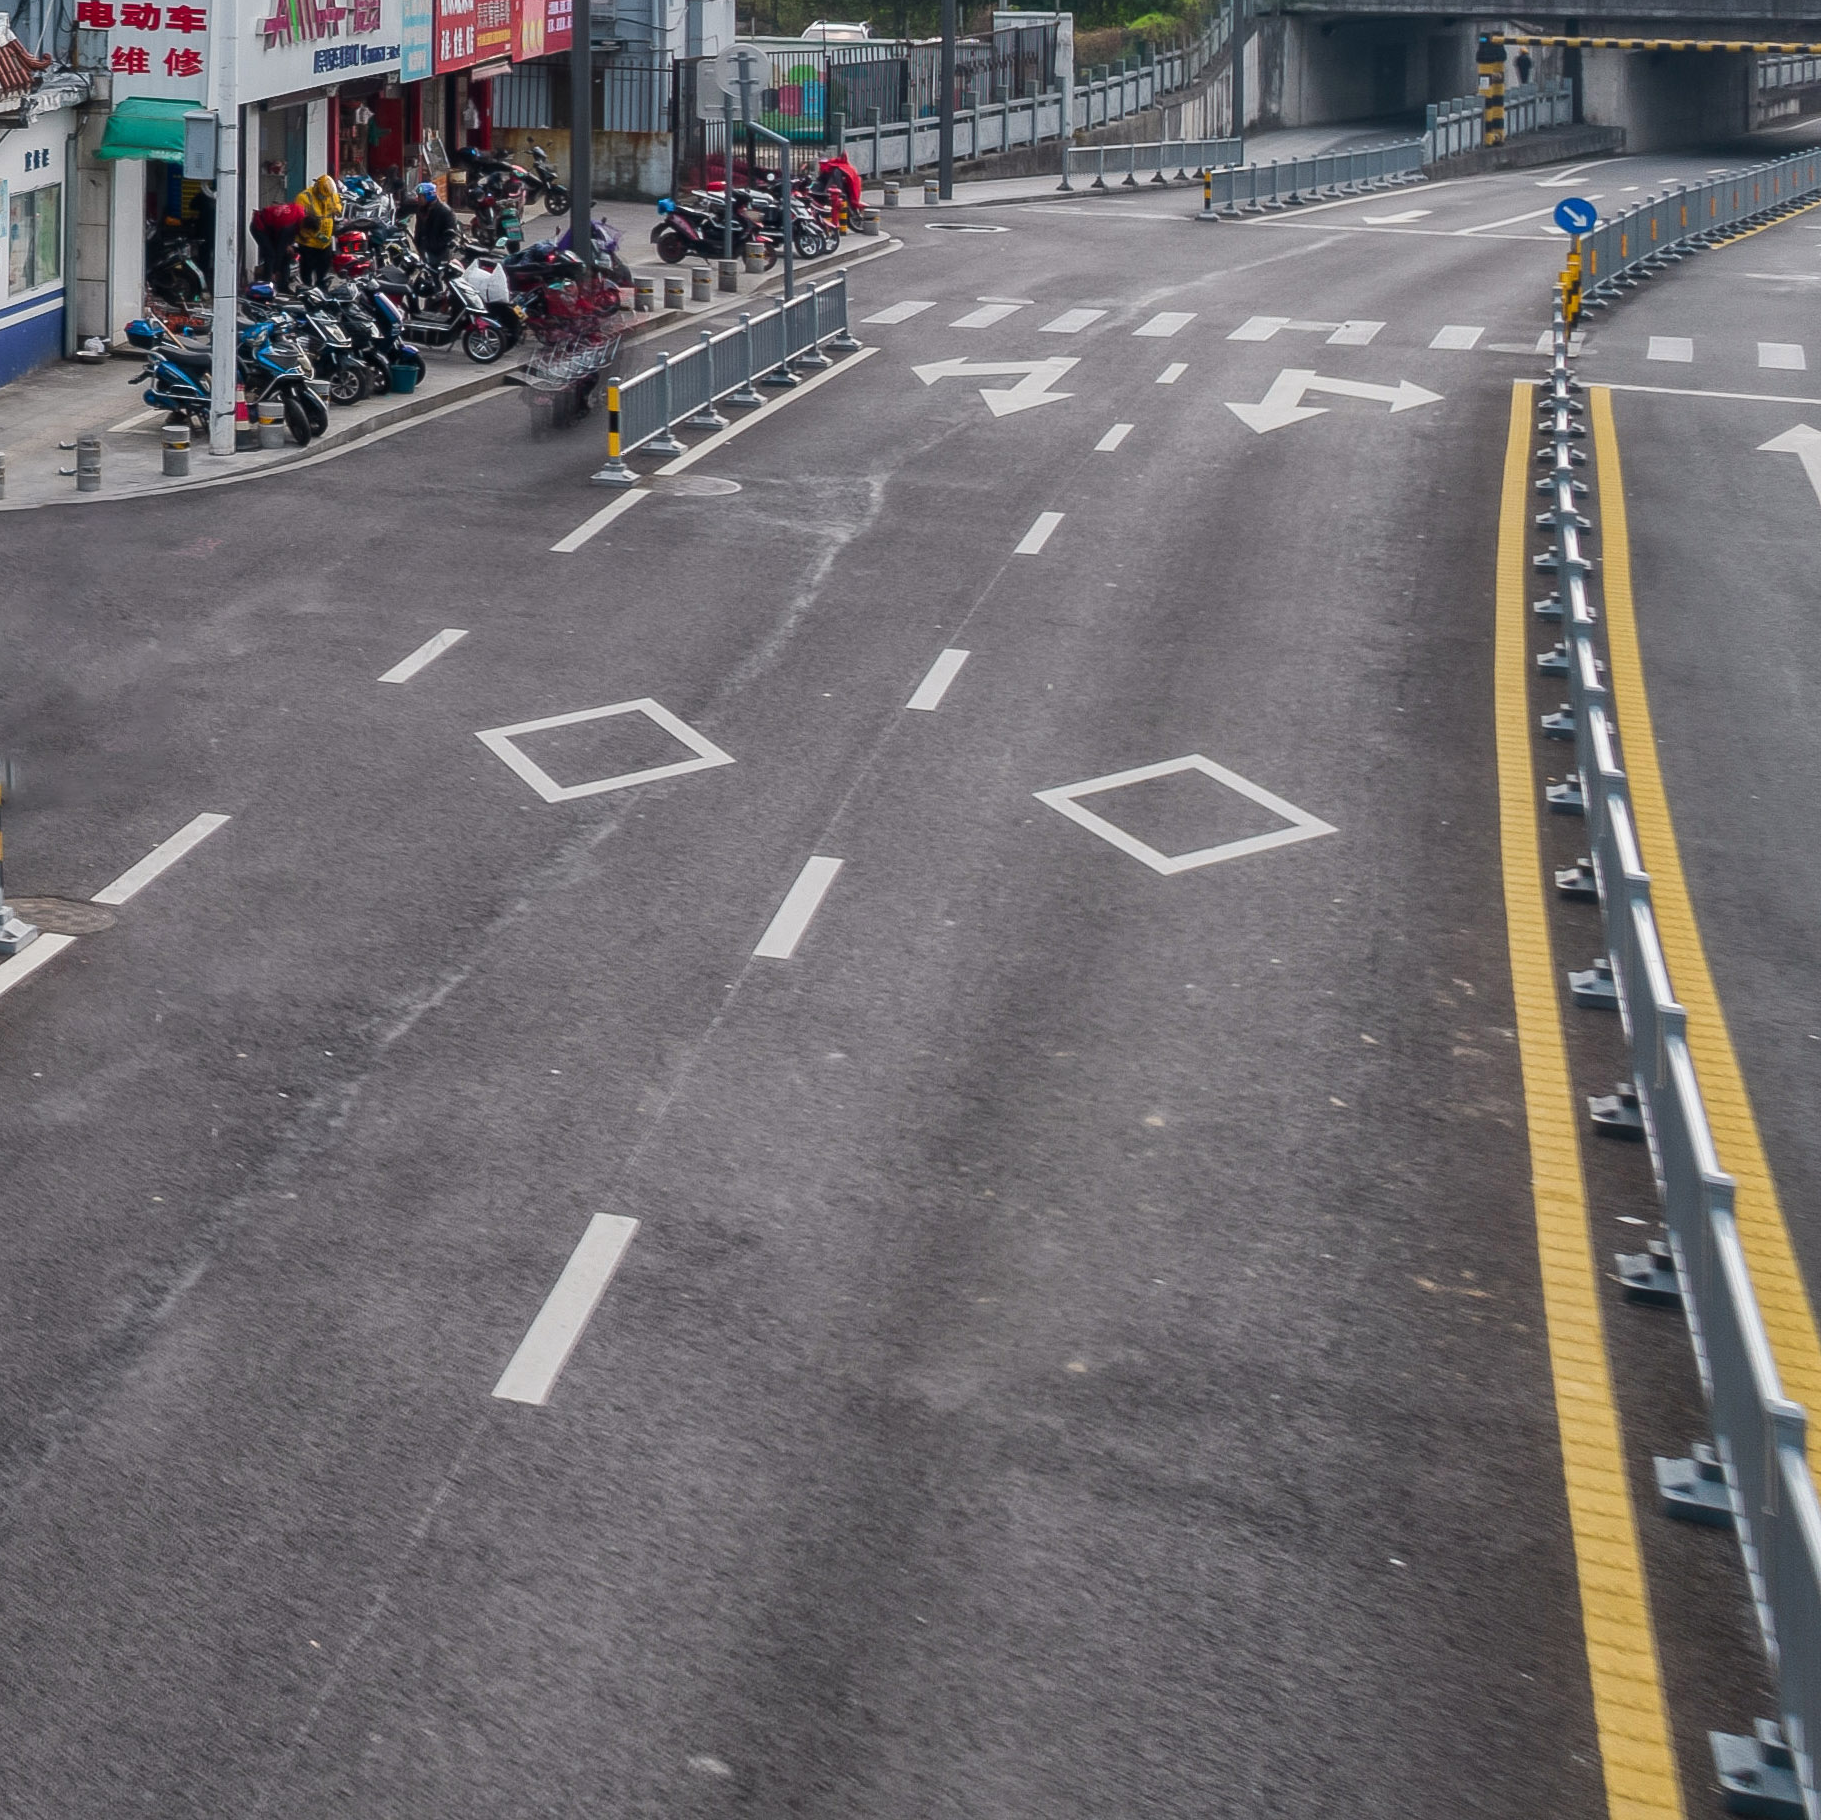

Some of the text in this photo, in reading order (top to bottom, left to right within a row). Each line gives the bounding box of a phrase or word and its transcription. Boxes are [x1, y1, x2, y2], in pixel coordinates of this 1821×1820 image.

[77, 0, 207, 34] 电动车
[111, 46, 204, 78] 维修
